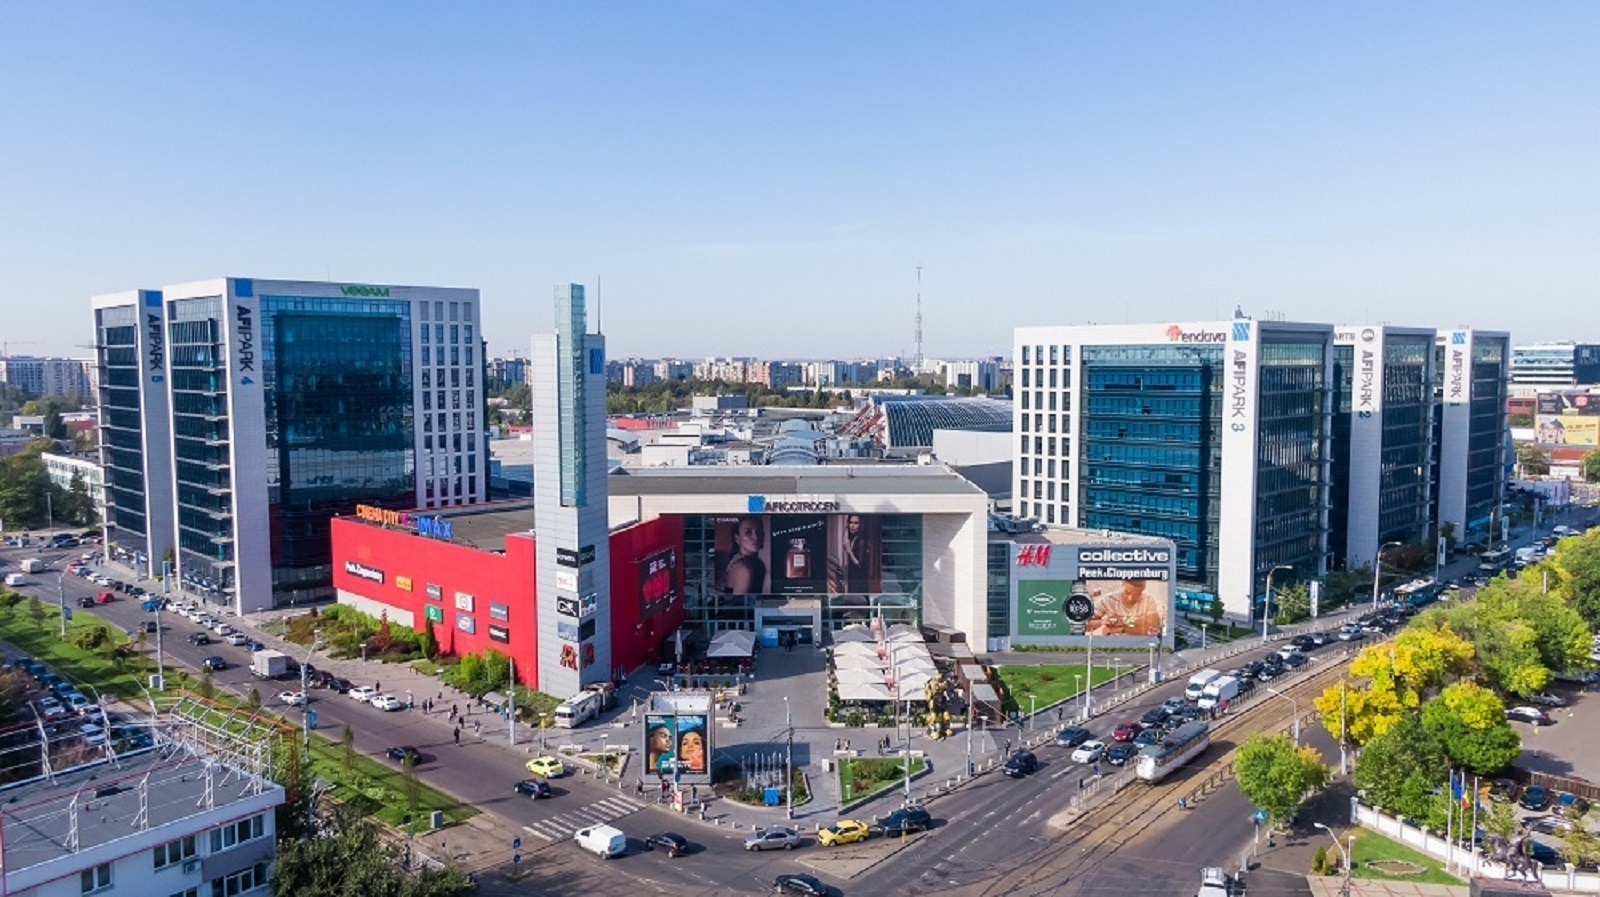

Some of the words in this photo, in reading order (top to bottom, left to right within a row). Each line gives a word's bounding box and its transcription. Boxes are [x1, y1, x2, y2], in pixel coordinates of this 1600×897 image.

[236, 304, 254, 372] AFIPARK
[1182, 329, 1227, 342] endava
[241, 375, 254, 385] 4
[1231, 349, 1247, 418] AFIPARK
[1360, 350, 1374, 408] AFIPARK
[1359, 410, 1372, 419] 2
[1231, 422, 1246, 433] 3
[416, 515, 453, 538] IMAX
[1015, 544, 1051, 568] H&M
[1079, 549, 1169, 562] collective
